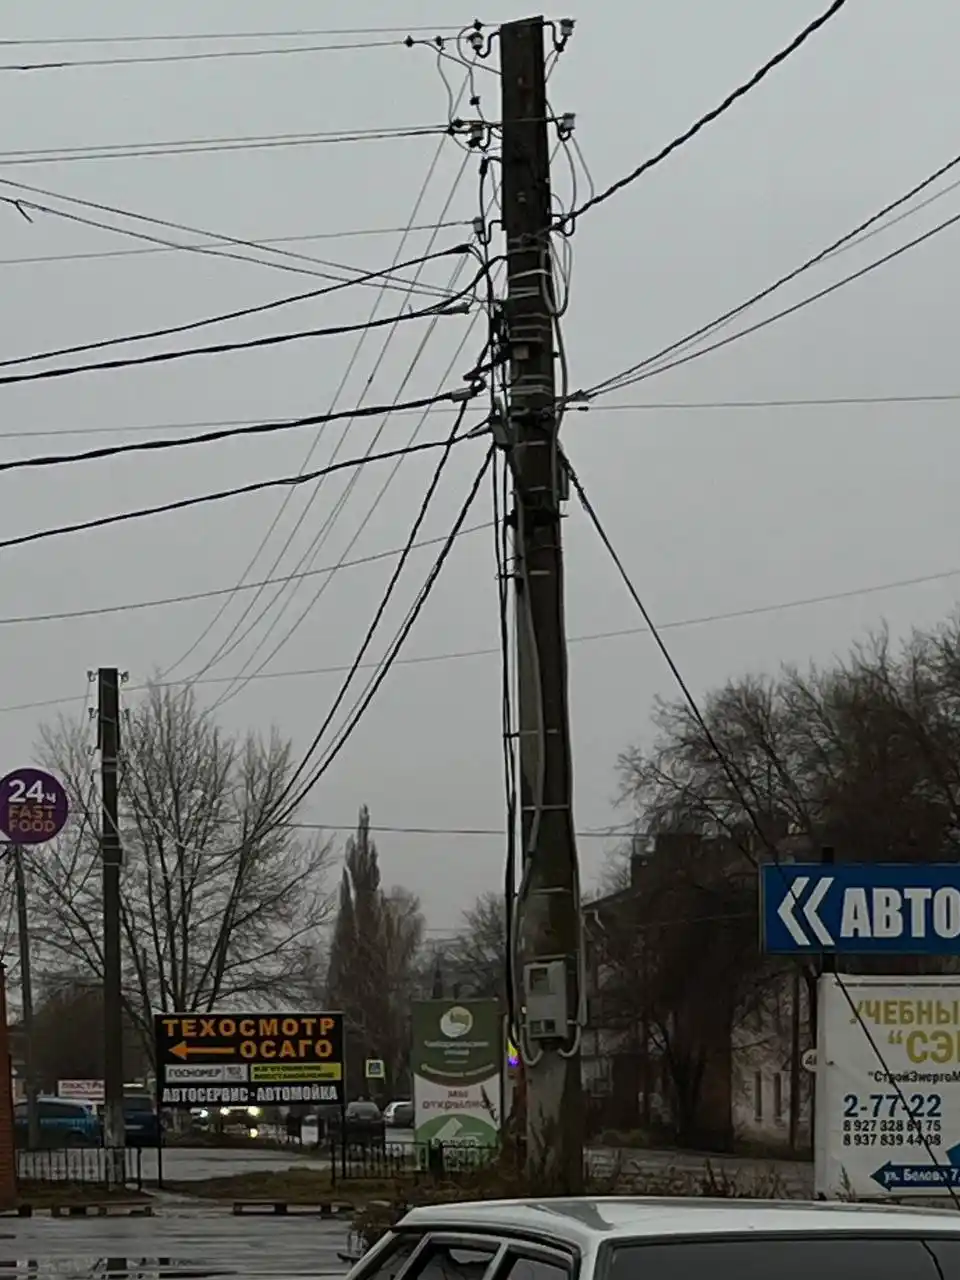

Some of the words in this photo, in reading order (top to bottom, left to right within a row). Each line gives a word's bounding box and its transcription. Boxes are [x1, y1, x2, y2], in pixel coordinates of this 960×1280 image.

[8, 804, 57, 819] FAST
[8, 819, 56, 832] FOOD
[162, 1018, 335, 1037] ТЕХОСМОТР
[239, 1039, 333, 1059] ОСАГО
[162, 1087, 249, 1103] АВТОСЕРВИС
[256, 1084, 338, 1102] АВТОМОЙКА
[843, 1120, 851, 1132] 8
[853, 1120, 877, 1132] 927
[880, 1120, 904, 1132] 328
[925, 1120, 942, 1132] 75
[843, 1134, 851, 1146] 8
[853, 1134, 877, 1146] 937
[880, 1134, 904, 1146] 839
